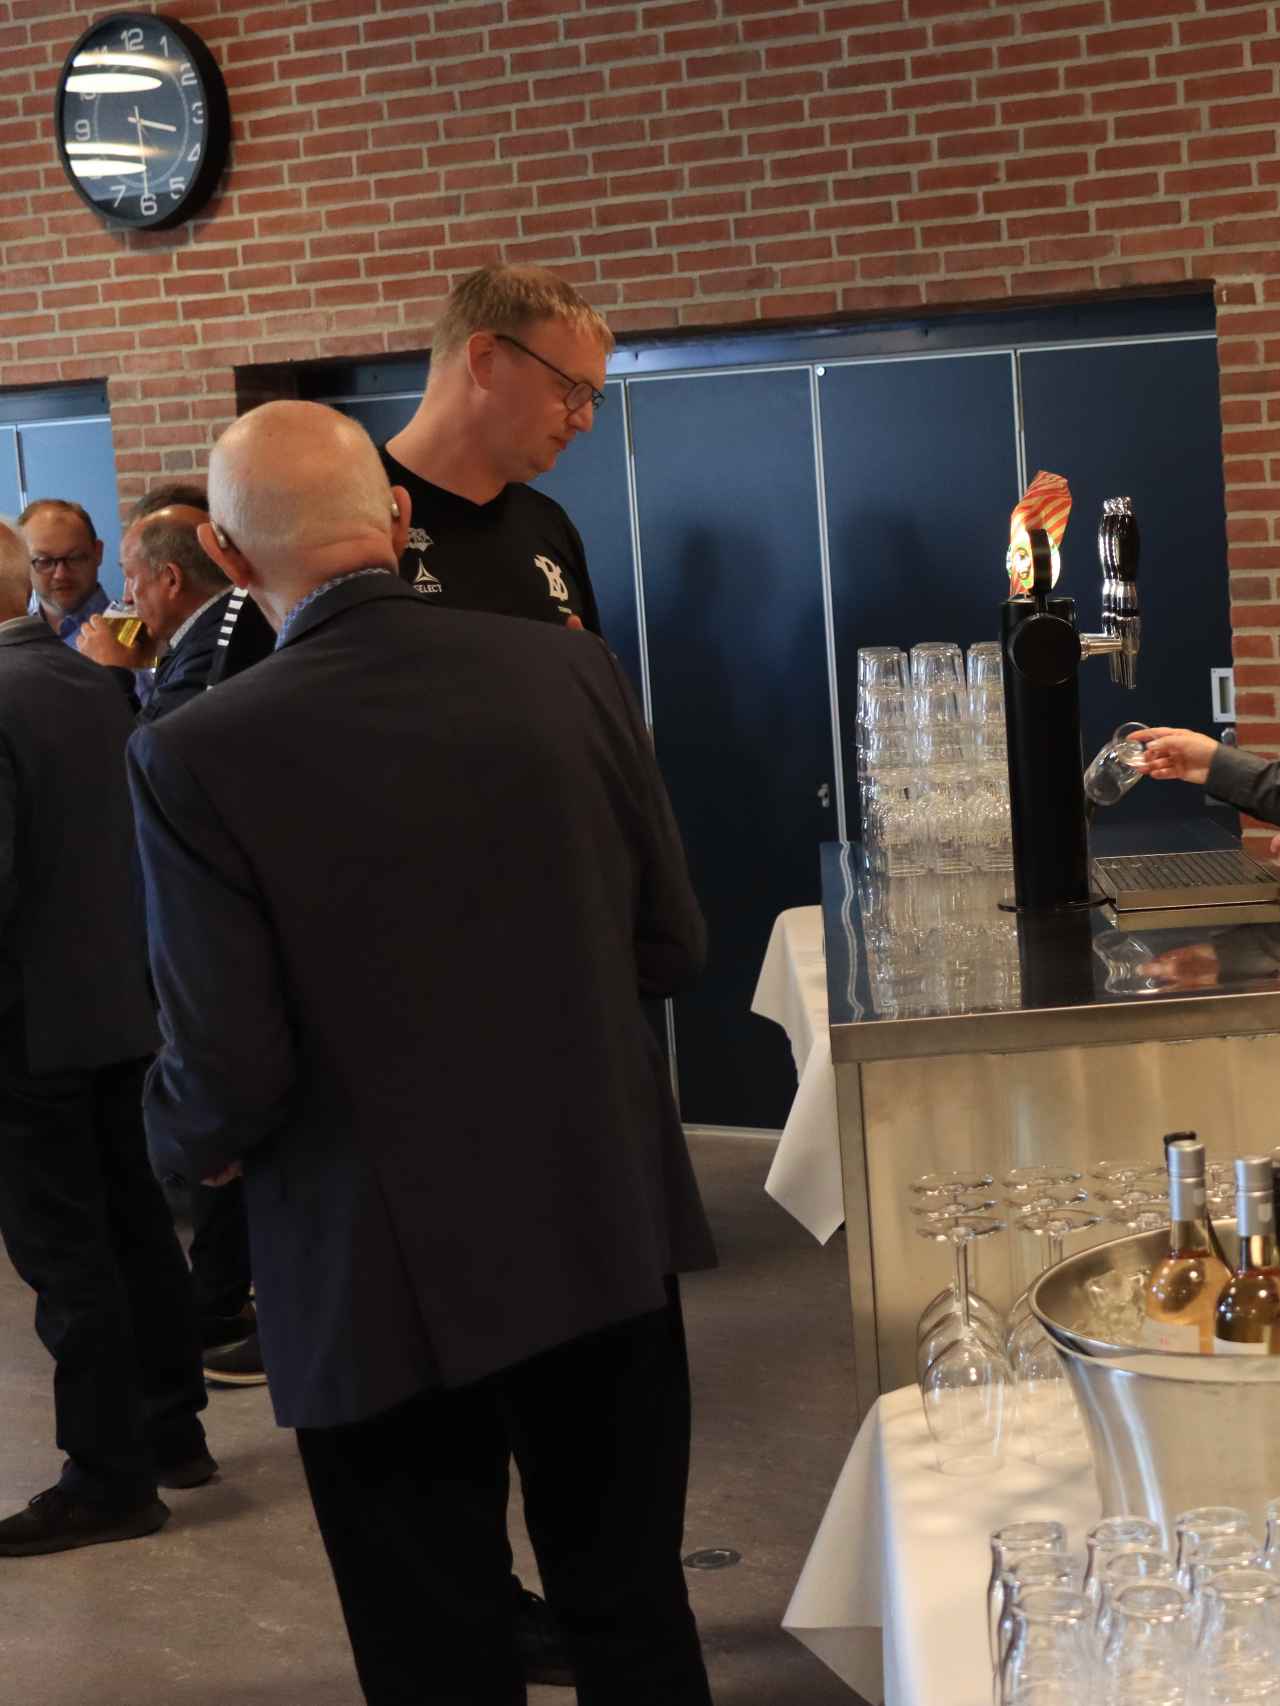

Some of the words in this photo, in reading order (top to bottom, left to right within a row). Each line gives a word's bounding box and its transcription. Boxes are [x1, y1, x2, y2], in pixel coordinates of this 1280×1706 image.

[121, 28, 145, 51] 12
[160, 35, 169, 57] 1
[180, 62, 198, 87] 2
[192, 101, 204, 125] 3
[74, 119, 91, 142] 9
[187, 143, 200, 162] 4
[111, 184, 126, 208] 7
[168, 176, 186, 200] 5
[140, 193, 158, 216] 6
